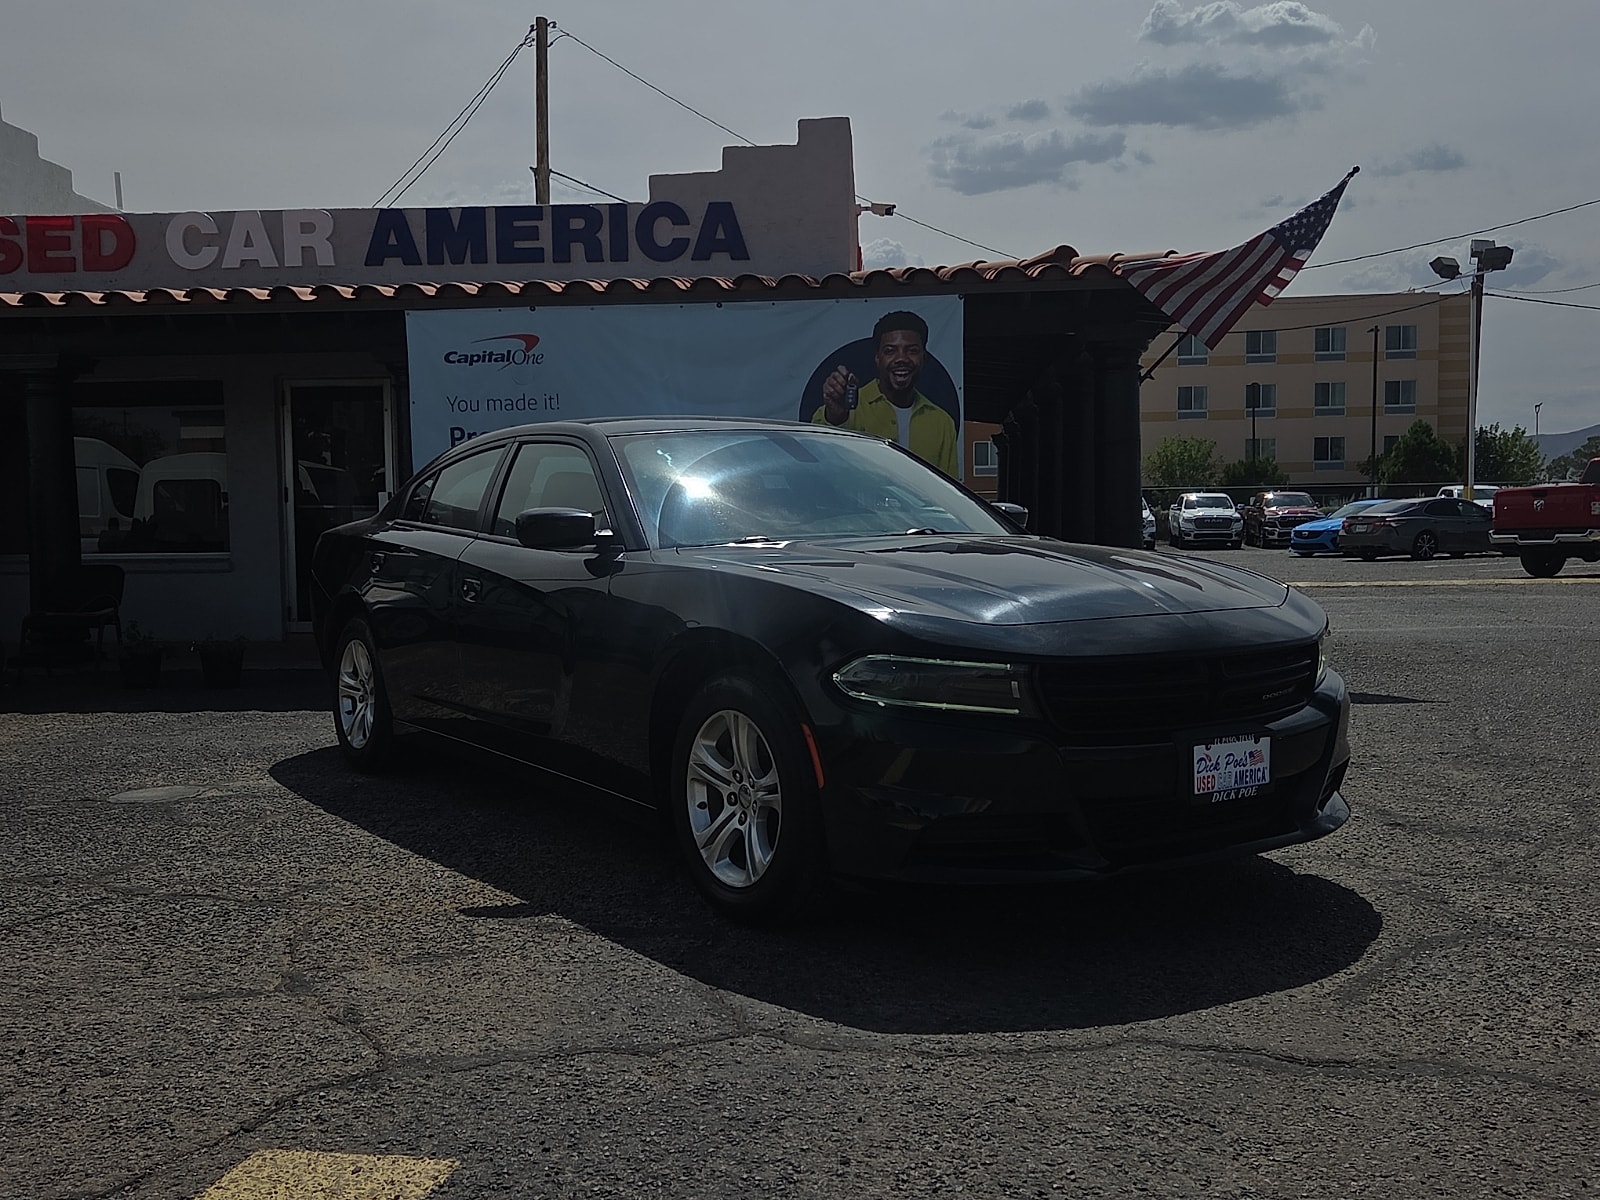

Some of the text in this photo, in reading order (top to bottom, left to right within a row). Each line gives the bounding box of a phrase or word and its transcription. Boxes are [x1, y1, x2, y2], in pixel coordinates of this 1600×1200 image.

[165, 208, 336, 271] CAR
[364, 201, 751, 266] AMERICA
[446, 392, 560, 413] You made it!
[449, 426, 490, 448] Pr
[1196, 751, 1249, 775] Dick Poe's
[1196, 775, 1216, 793] USED
[1233, 766, 1267, 787] AMERICA
[1211, 786, 1259, 803] DICK POE
